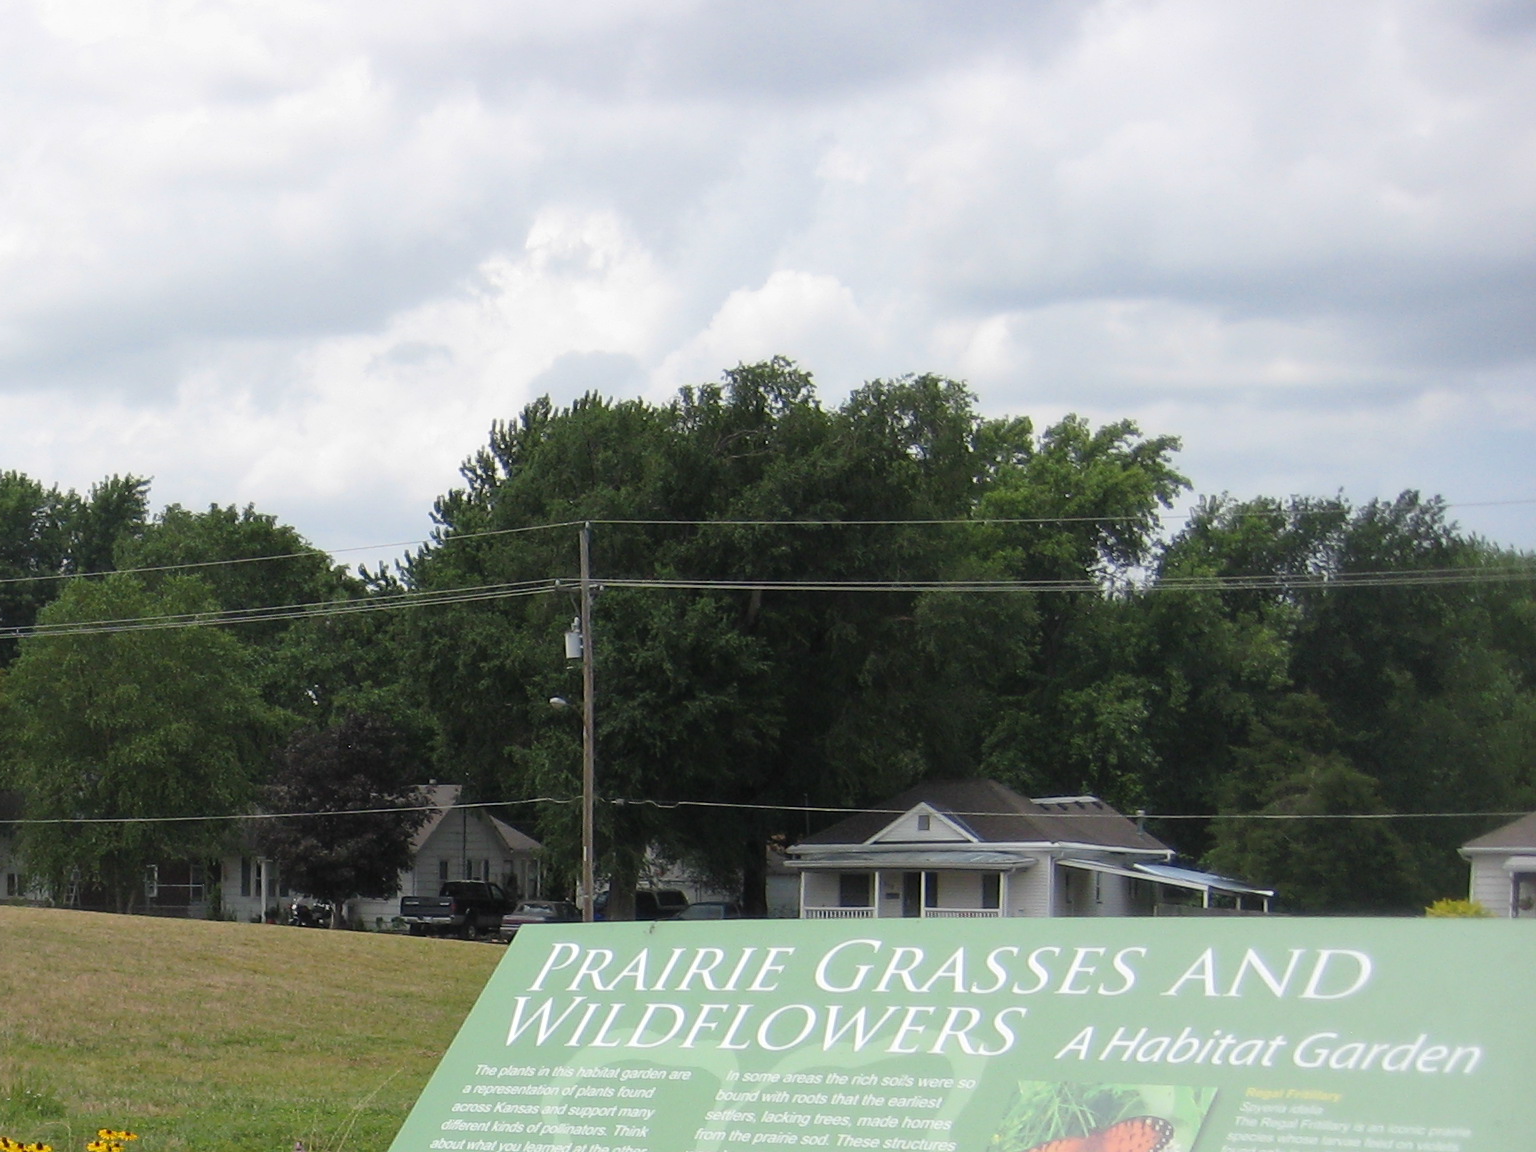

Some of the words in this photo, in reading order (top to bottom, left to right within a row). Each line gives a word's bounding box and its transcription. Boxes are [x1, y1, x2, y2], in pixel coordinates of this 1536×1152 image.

[527, 942, 795, 992] PRAIRIE
[814, 939, 1147, 996] GRASSES
[1159, 947, 1374, 999] AND
[504, 996, 1027, 1056] WILDFLOWERS
[1054, 1027, 1094, 1060] A
[1099, 1027, 1287, 1067] Habitat
[1293, 1032, 1482, 1073] Garden
[476, 1062, 497, 1076] The
[497, 1063, 536, 1079] plants
[537, 1064, 550, 1077] in
[551, 1064, 574, 1077] this
[576, 1065, 621, 1079] habitat
[619, 1066, 666, 1082] garden
[669, 1071, 691, 1080] are
[727, 1069, 738, 1083] In
[742, 1074, 779, 1084] some
[783, 1074, 822, 1084] areas
[825, 1071, 848, 1085] the
[851, 1072, 879, 1086] rich
[881, 1073, 914, 1086] soils
[917, 1077, 953, 1087] were
[957, 1078, 977, 1088] so
[462, 1085, 471, 1094] a
[473, 1082, 559, 1098] representation
[561, 1083, 576, 1096] of
[574, 1084, 615, 1100] plants
[617, 1084, 656, 1098] found
[715, 1088, 760, 1102] bound
[761, 1090, 791, 1103] with
[791, 1091, 827, 1105] roots
[830, 1092, 860, 1106] that
[861, 1093, 884, 1107] the
[887, 1094, 942, 1108] earliest
[451, 1103, 491, 1113] across
[493, 1100, 538, 1115] Kansas
[541, 1102, 567, 1115] and
[568, 1104, 617, 1120] support
[618, 1108, 654, 1121] many
[761, 1109, 810, 1128] lacking
[857, 1114, 898, 1128] made
[901, 1115, 952, 1129] homes
[440, 1118, 491, 1132] different
[491, 1119, 524, 1133] kinds
[526, 1121, 541, 1134] of
[615, 1123, 650, 1137] Think
[430, 1137, 466, 1150] about
[466, 1138, 497, 1152] what
[694, 1127, 725, 1141] from
[728, 1129, 750, 1143] the
[751, 1130, 797, 1147] prairie
[838, 1133, 880, 1148] These
[883, 1135, 957, 1151] structures
